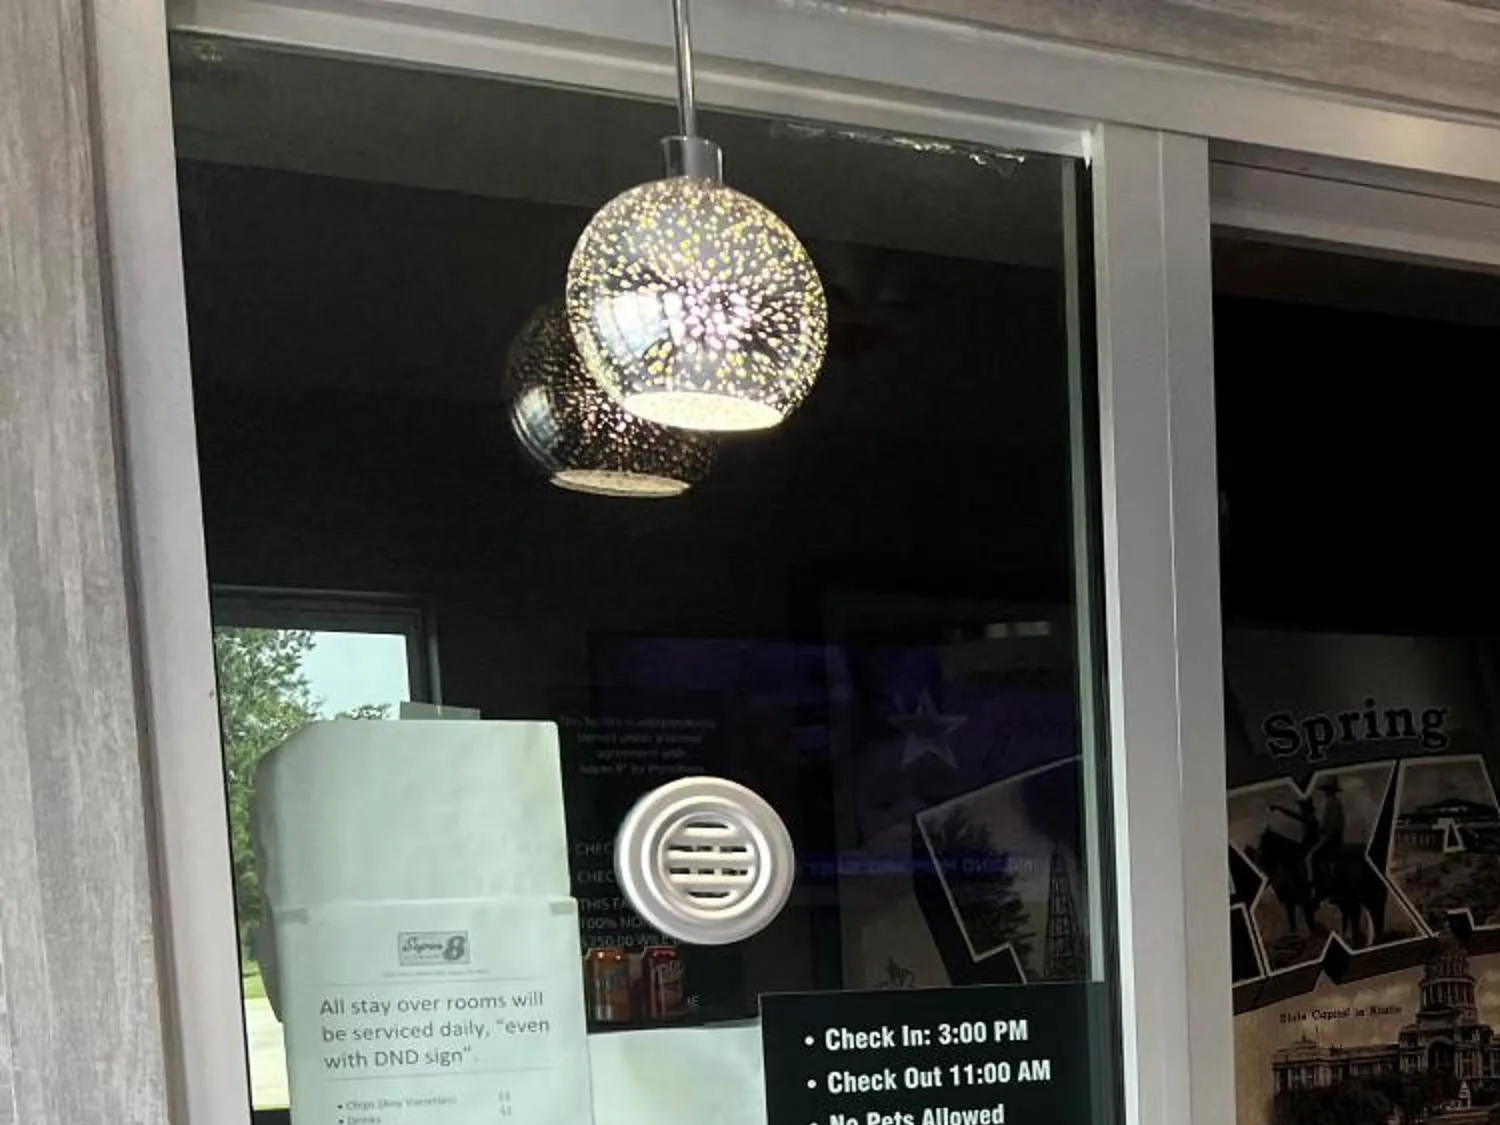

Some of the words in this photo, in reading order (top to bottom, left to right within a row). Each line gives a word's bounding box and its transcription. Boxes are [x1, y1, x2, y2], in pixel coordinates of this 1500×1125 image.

[1263, 699, 1450, 760] Spring
[320, 999, 345, 1015] All
[350, 998, 391, 1016] stay
[397, 999, 440, 1012] over
[447, 996, 507, 1010] rooms
[511, 991, 544, 1008] will
[322, 1025, 347, 1042] be
[352, 1022, 434, 1040] serviced
[439, 1019, 491, 1038] daily,
[825, 1027, 894, 1051] Check
[902, 1024, 931, 1046] In:
[938, 1021, 987, 1044] 3:00
[994, 1019, 1029, 1042] PM
[323, 1051, 368, 1069] with
[375, 1050, 419, 1067] DND
[827, 1069, 897, 1094] Check
[904, 1066, 942, 1089] Out
[950, 1061, 1011, 1086] 11:00
[1018, 1059, 1051, 1082] AM
